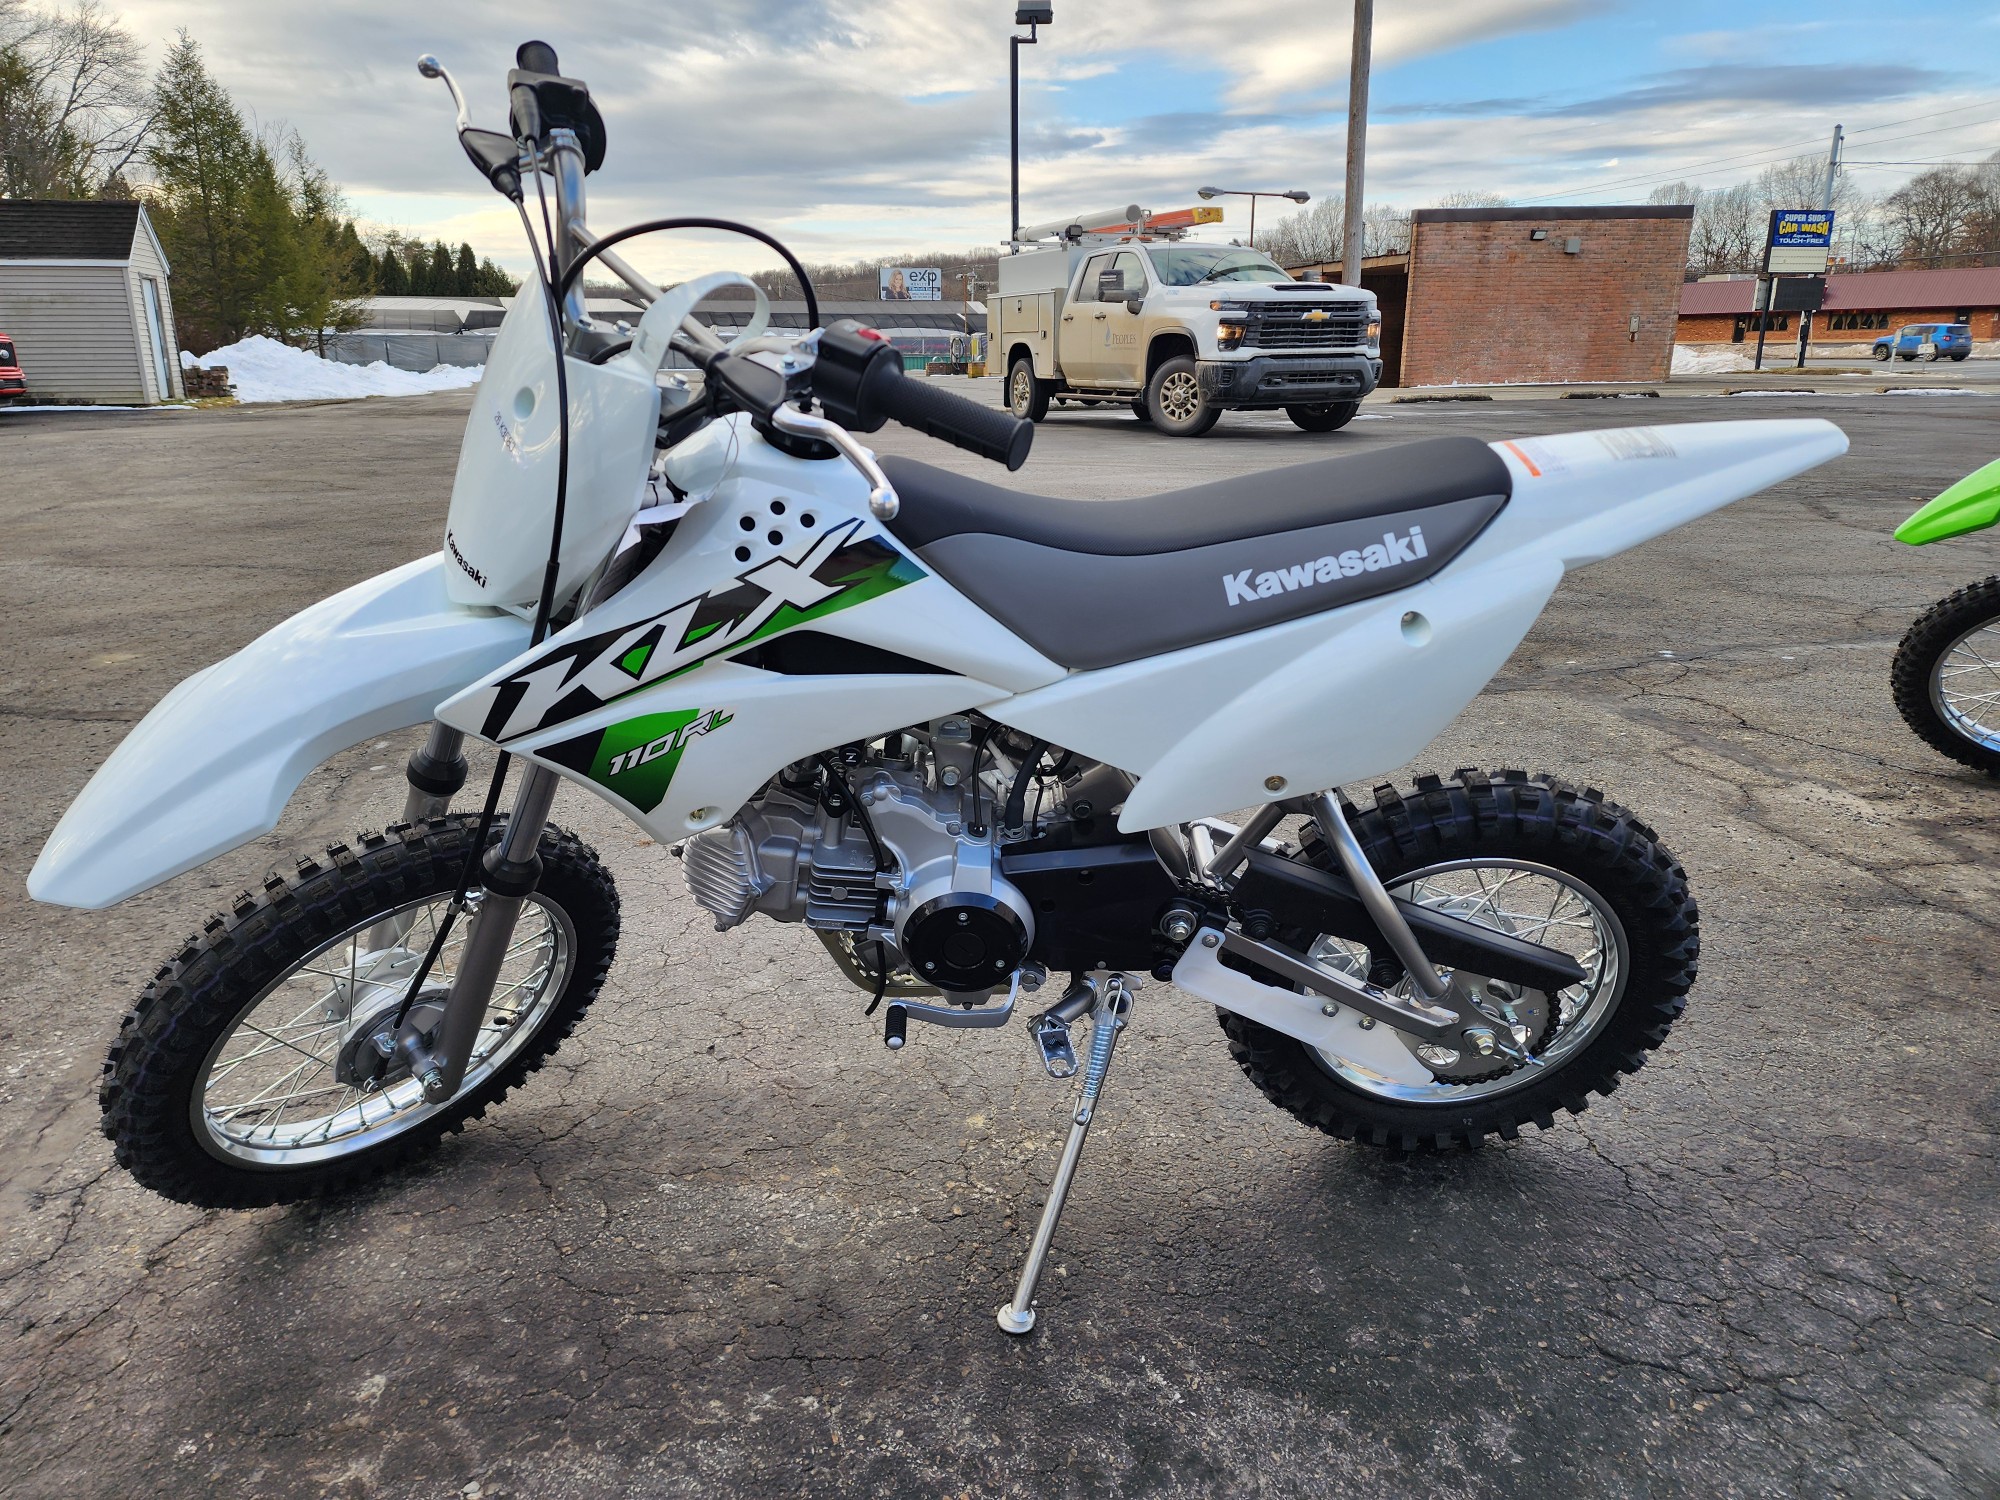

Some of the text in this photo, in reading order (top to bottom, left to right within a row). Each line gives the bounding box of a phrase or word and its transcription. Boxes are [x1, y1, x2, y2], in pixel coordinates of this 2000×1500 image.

[1779, 221, 1829, 235] CAR WASH
[447, 529, 487, 588] Kawasaki
[1223, 525, 1428, 607] Kawasaki
[491, 518, 866, 742] KLX
